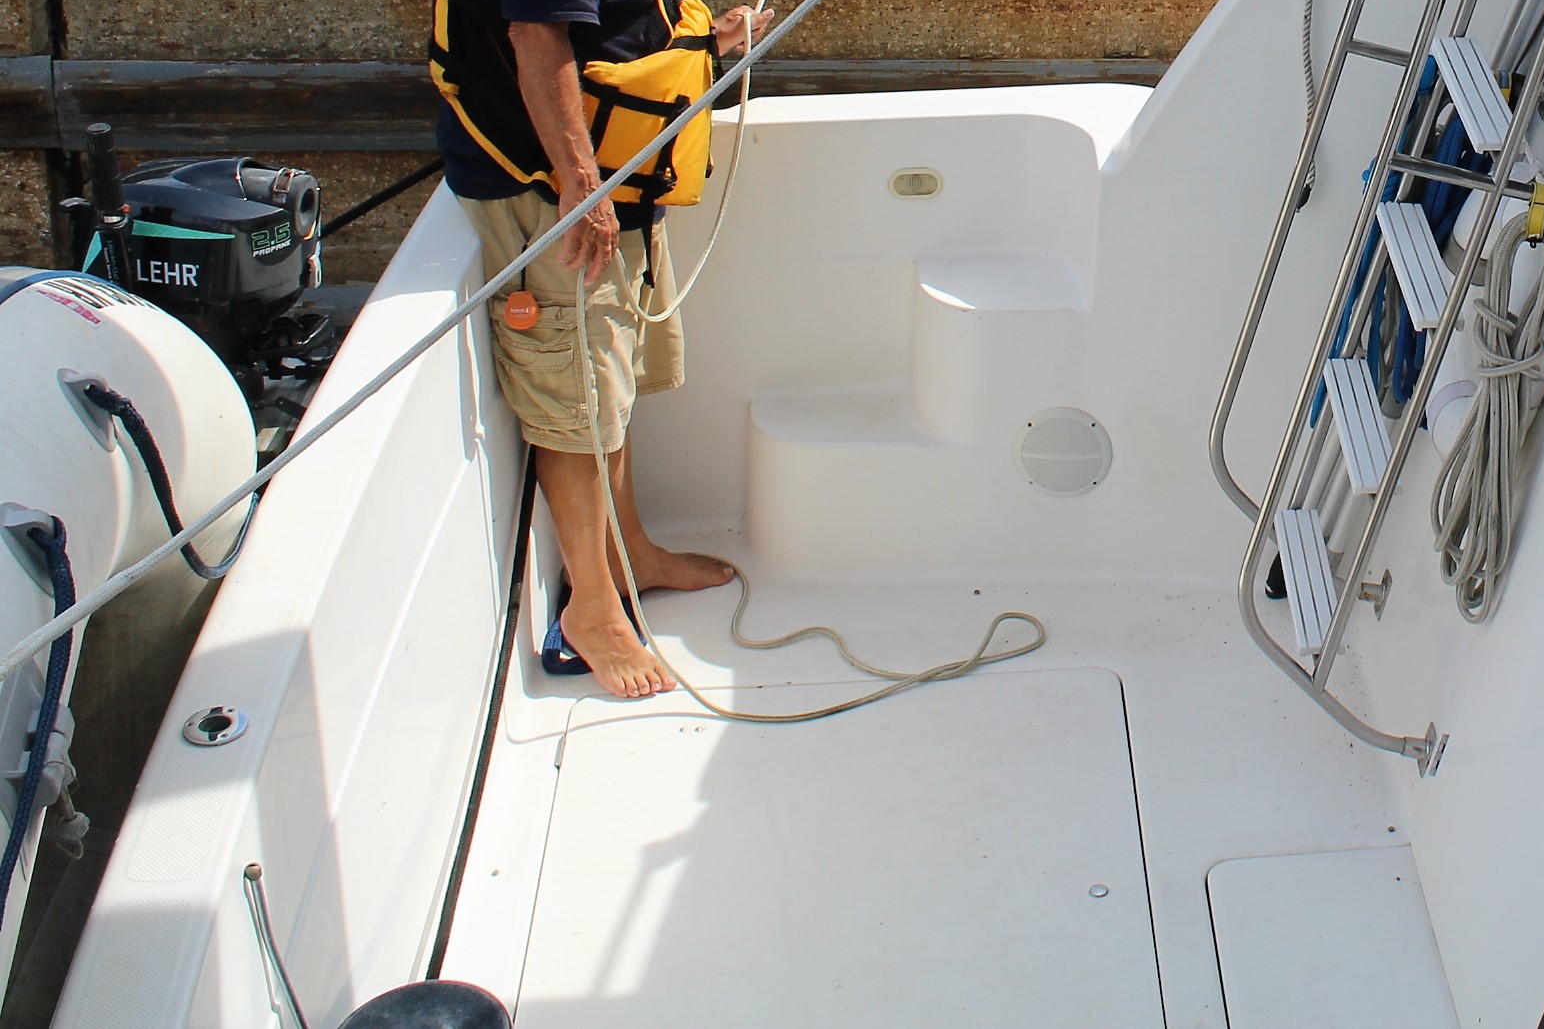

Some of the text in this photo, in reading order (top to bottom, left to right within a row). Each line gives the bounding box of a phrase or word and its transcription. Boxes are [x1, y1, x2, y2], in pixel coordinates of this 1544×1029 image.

[252, 222, 290, 250] 2.5
[253, 239, 292, 257] PROPANE
[136, 258, 198, 287] LEHR
